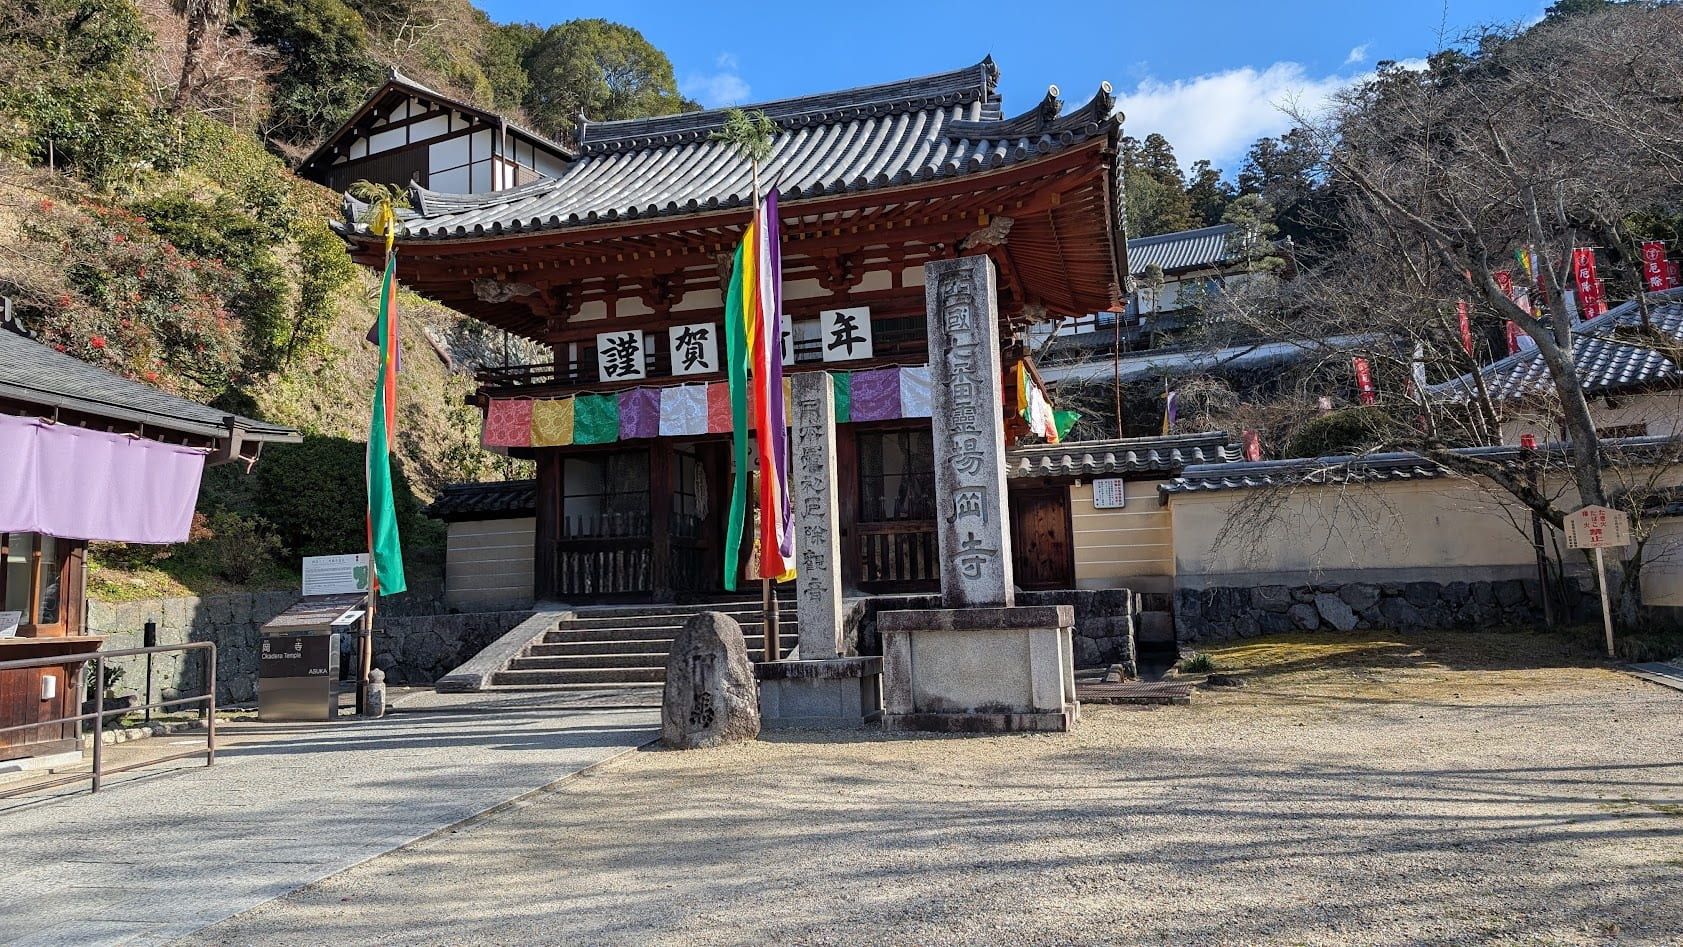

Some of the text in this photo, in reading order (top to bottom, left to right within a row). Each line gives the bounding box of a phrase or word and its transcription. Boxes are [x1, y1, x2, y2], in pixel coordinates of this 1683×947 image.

[599, 311, 867, 379] 謹賀年
[261, 651, 302, 660] Okadera Temple
